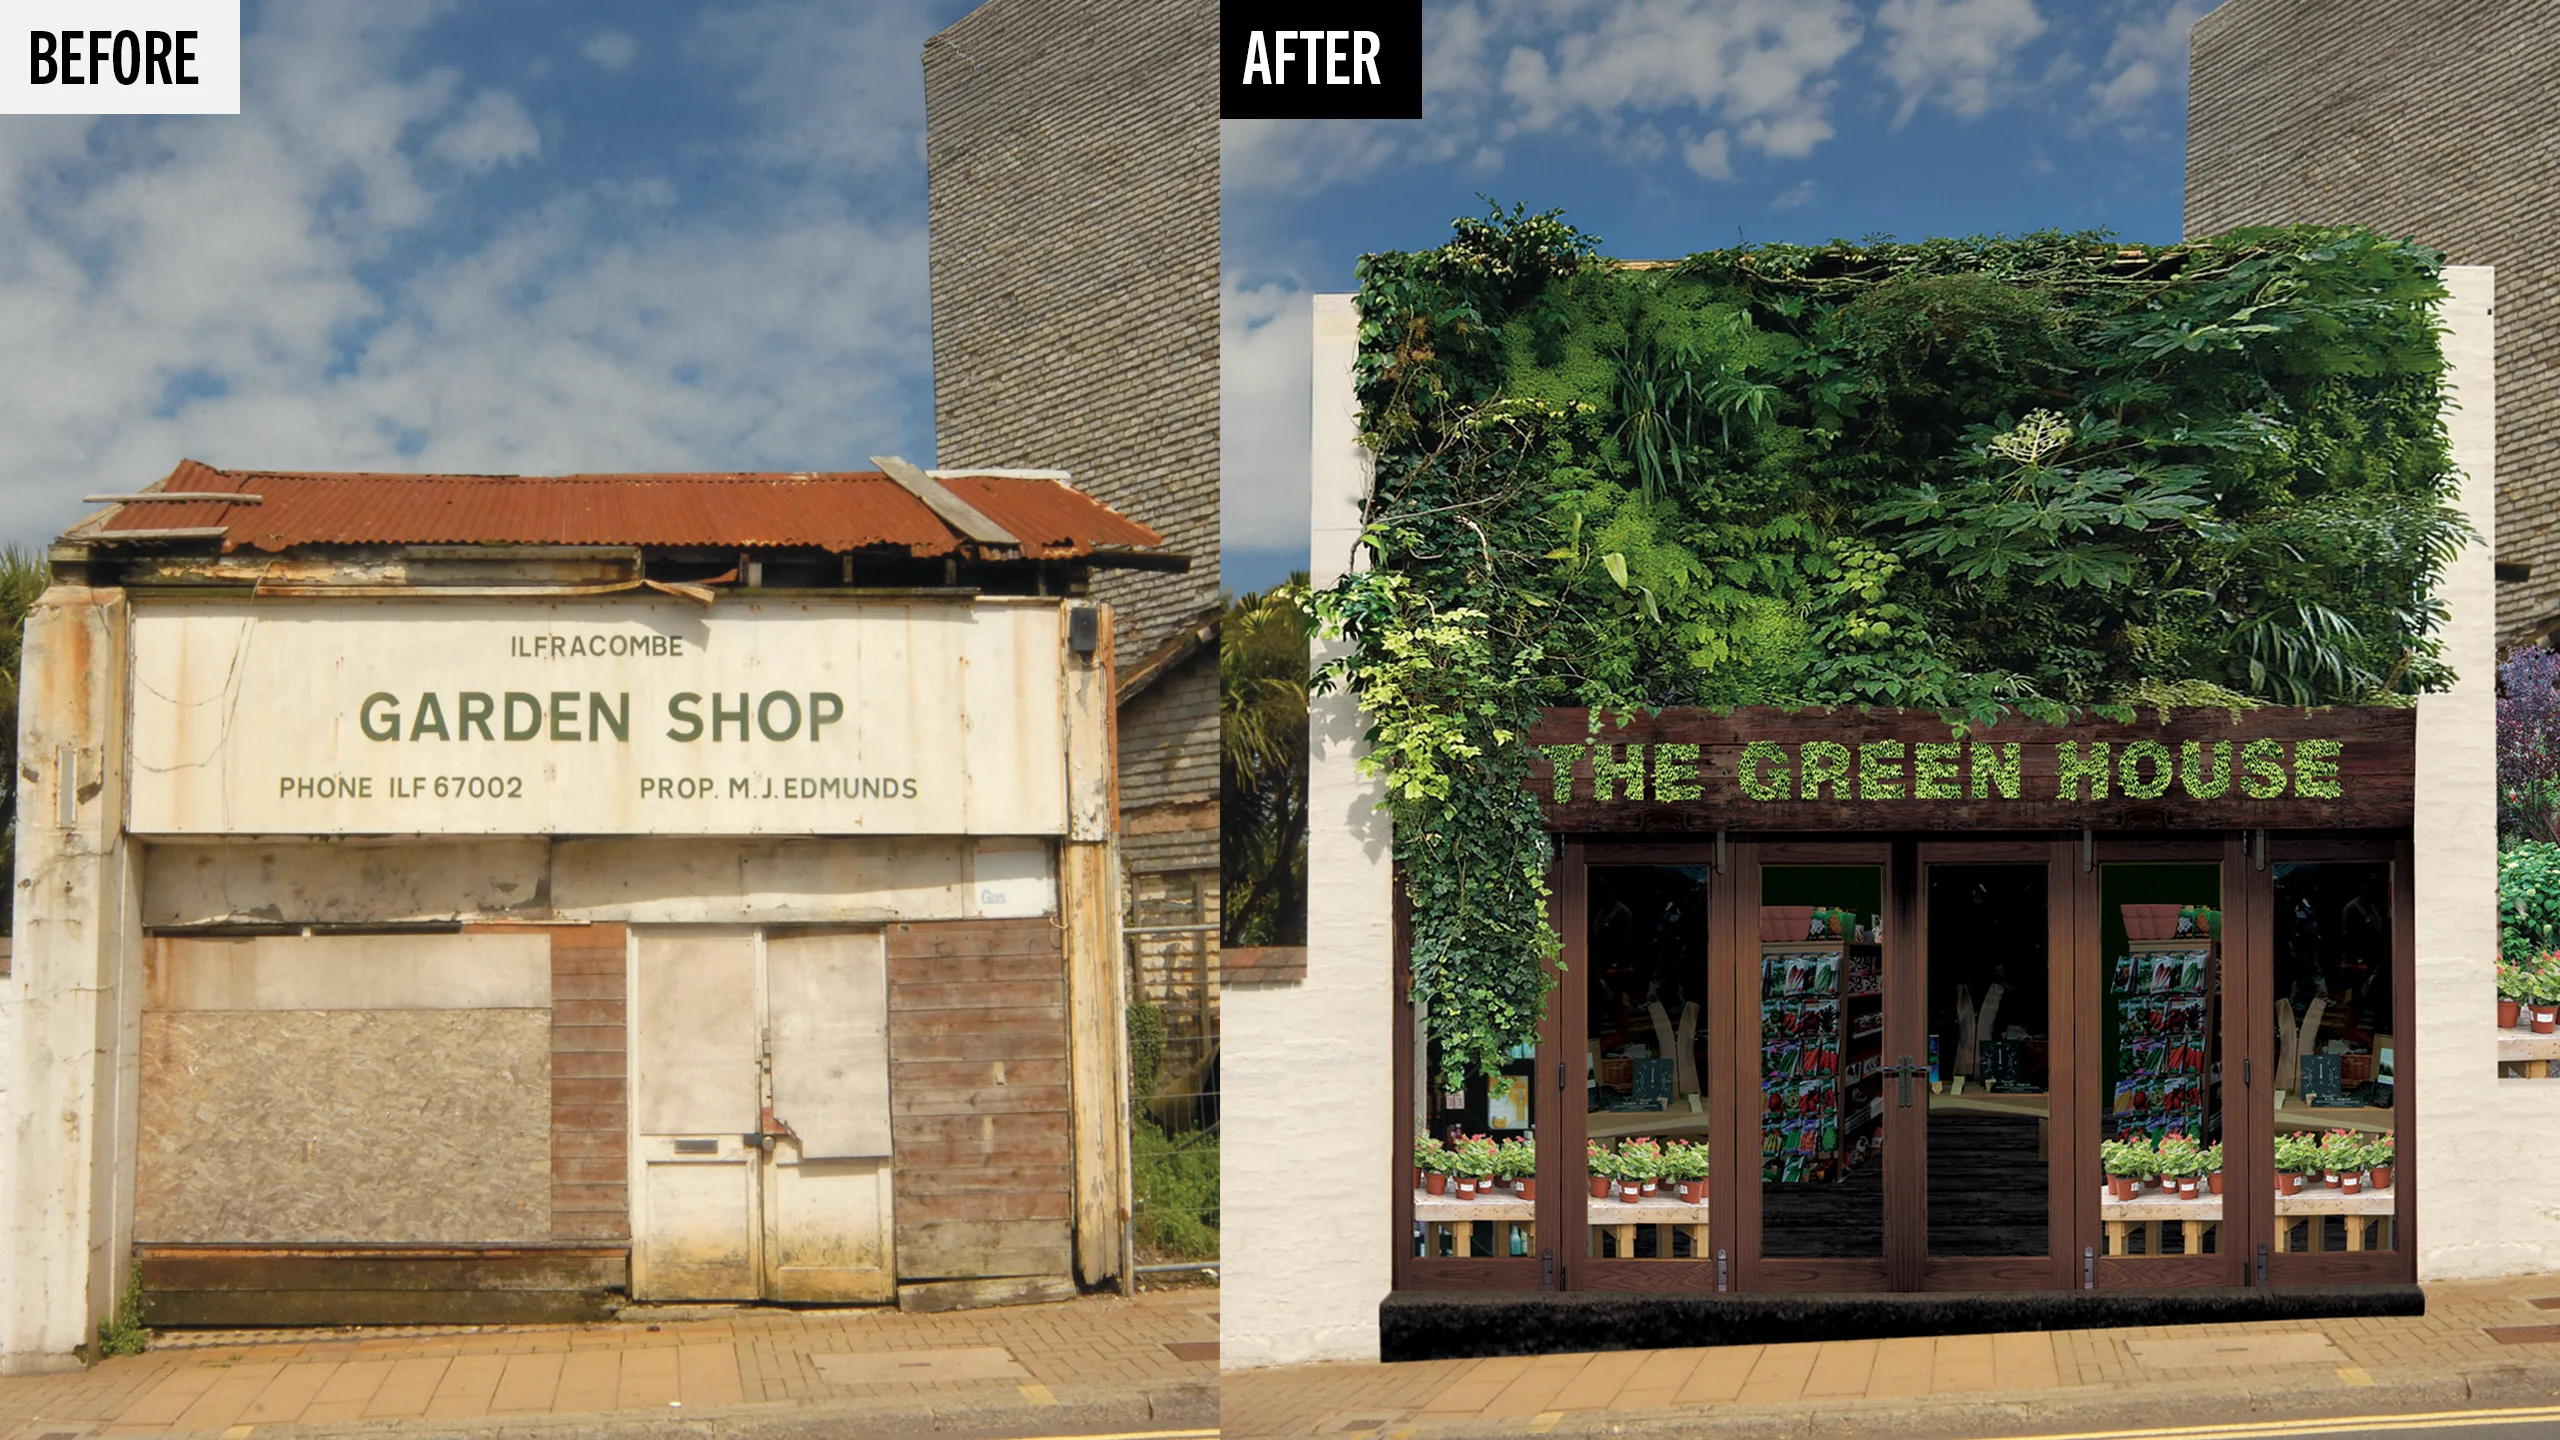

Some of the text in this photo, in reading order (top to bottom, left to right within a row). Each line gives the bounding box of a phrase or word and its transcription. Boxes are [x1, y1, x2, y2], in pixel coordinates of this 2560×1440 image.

[510, 634, 685, 658] ILFRACOMBE
[360, 690, 845, 743] GARDEN SHOP
[1540, 738, 2344, 803] THE GREEN HOUSE
[279, 775, 523, 799] PHONE ILF 67002
[639, 776, 720, 799] PROP.
[980, 889, 1007, 905] Gas
